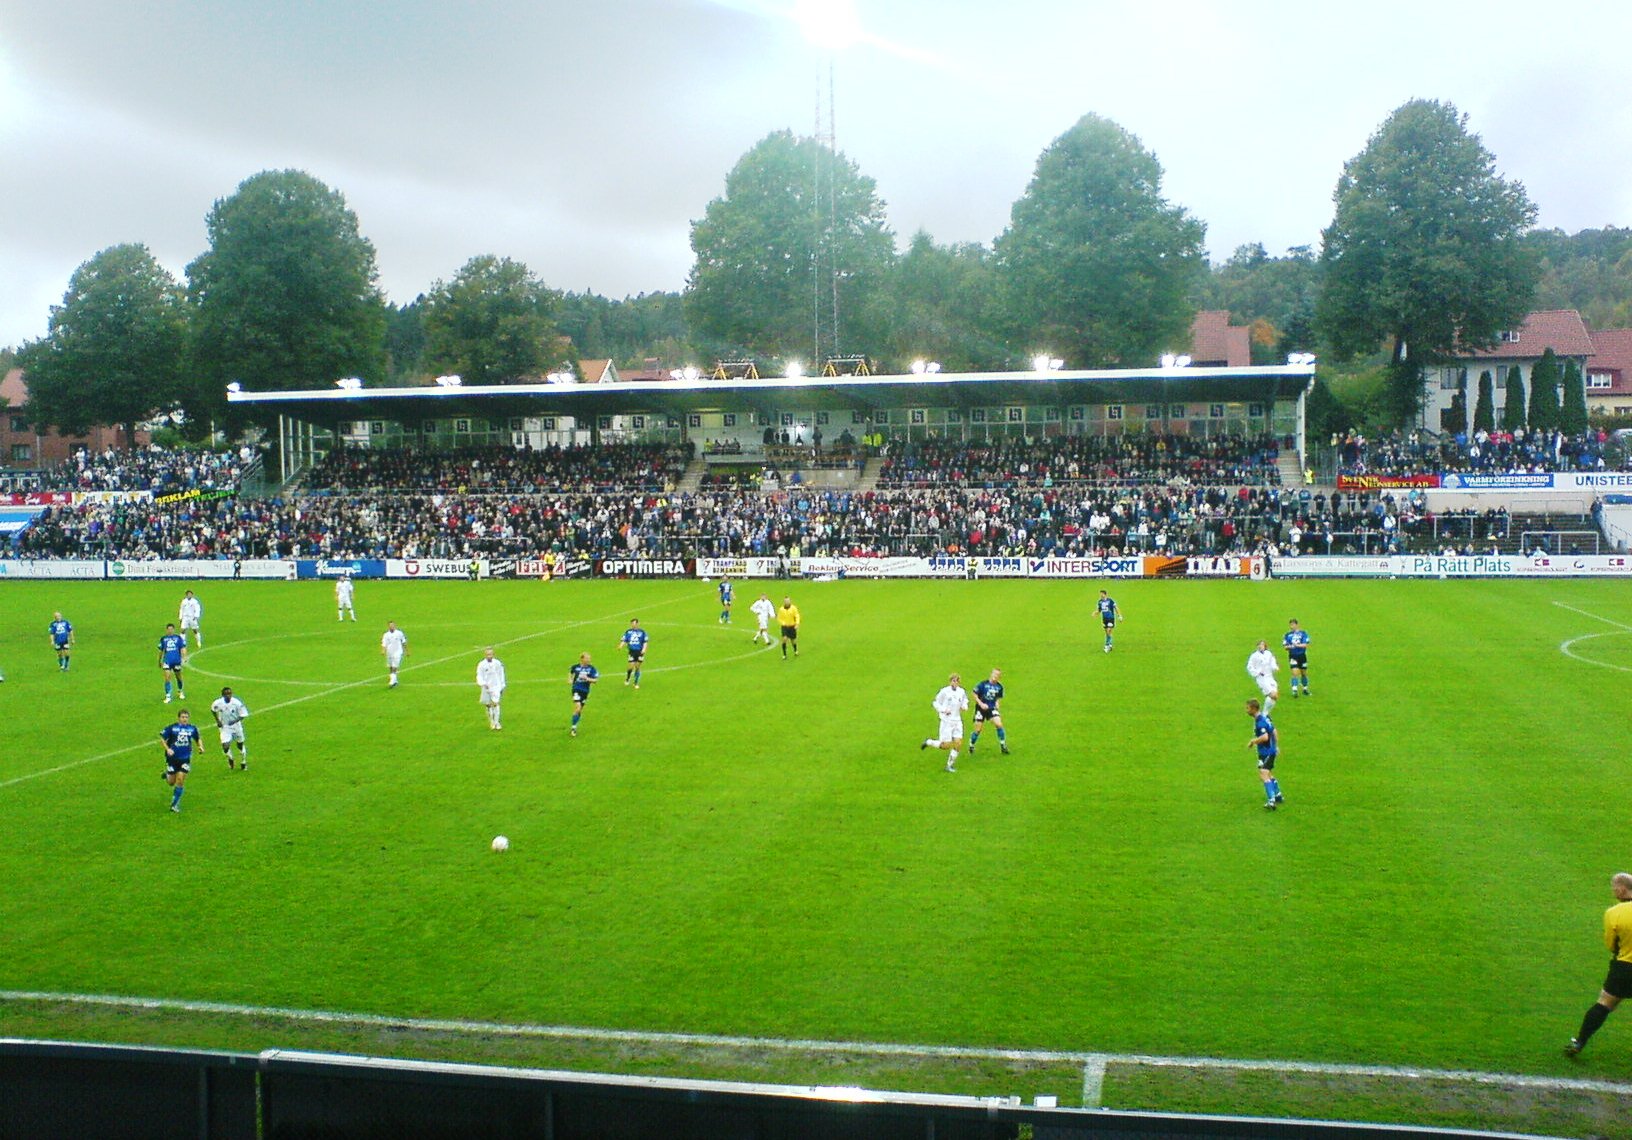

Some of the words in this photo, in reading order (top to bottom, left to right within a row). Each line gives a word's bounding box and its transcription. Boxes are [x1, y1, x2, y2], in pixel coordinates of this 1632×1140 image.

[1576, 476, 1632, 486] UNISTEE
[602, 560, 685, 574] OPTIMERA
[1047, 560, 1137, 573] INTERSPORT
[1473, 558, 1511, 572] Plats
